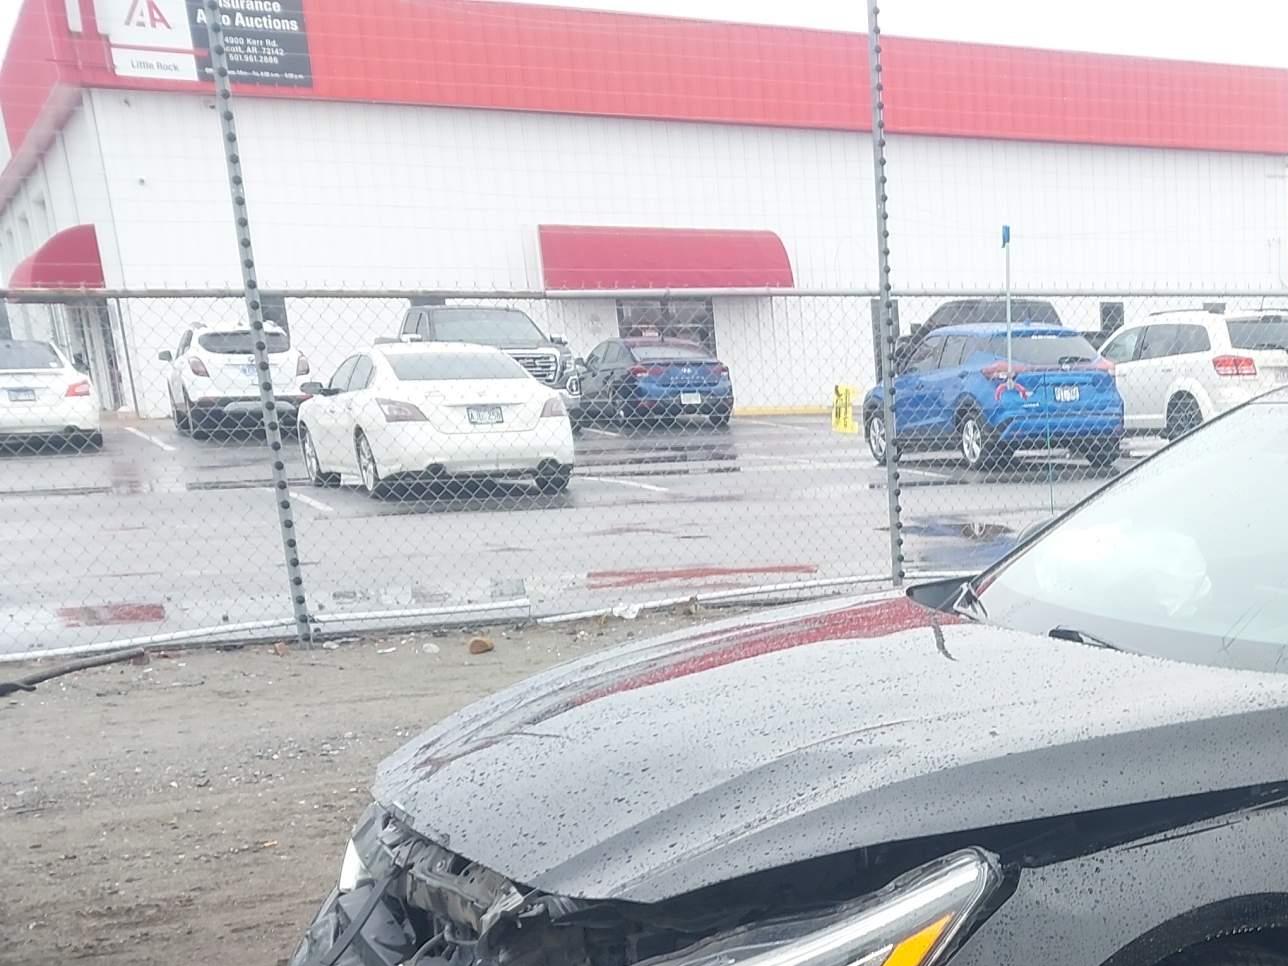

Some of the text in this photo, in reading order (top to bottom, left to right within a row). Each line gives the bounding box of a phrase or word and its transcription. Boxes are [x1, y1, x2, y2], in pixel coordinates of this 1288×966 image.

[234, 12, 299, 31] Auctions
[131, 59, 180, 72] Little Rock
